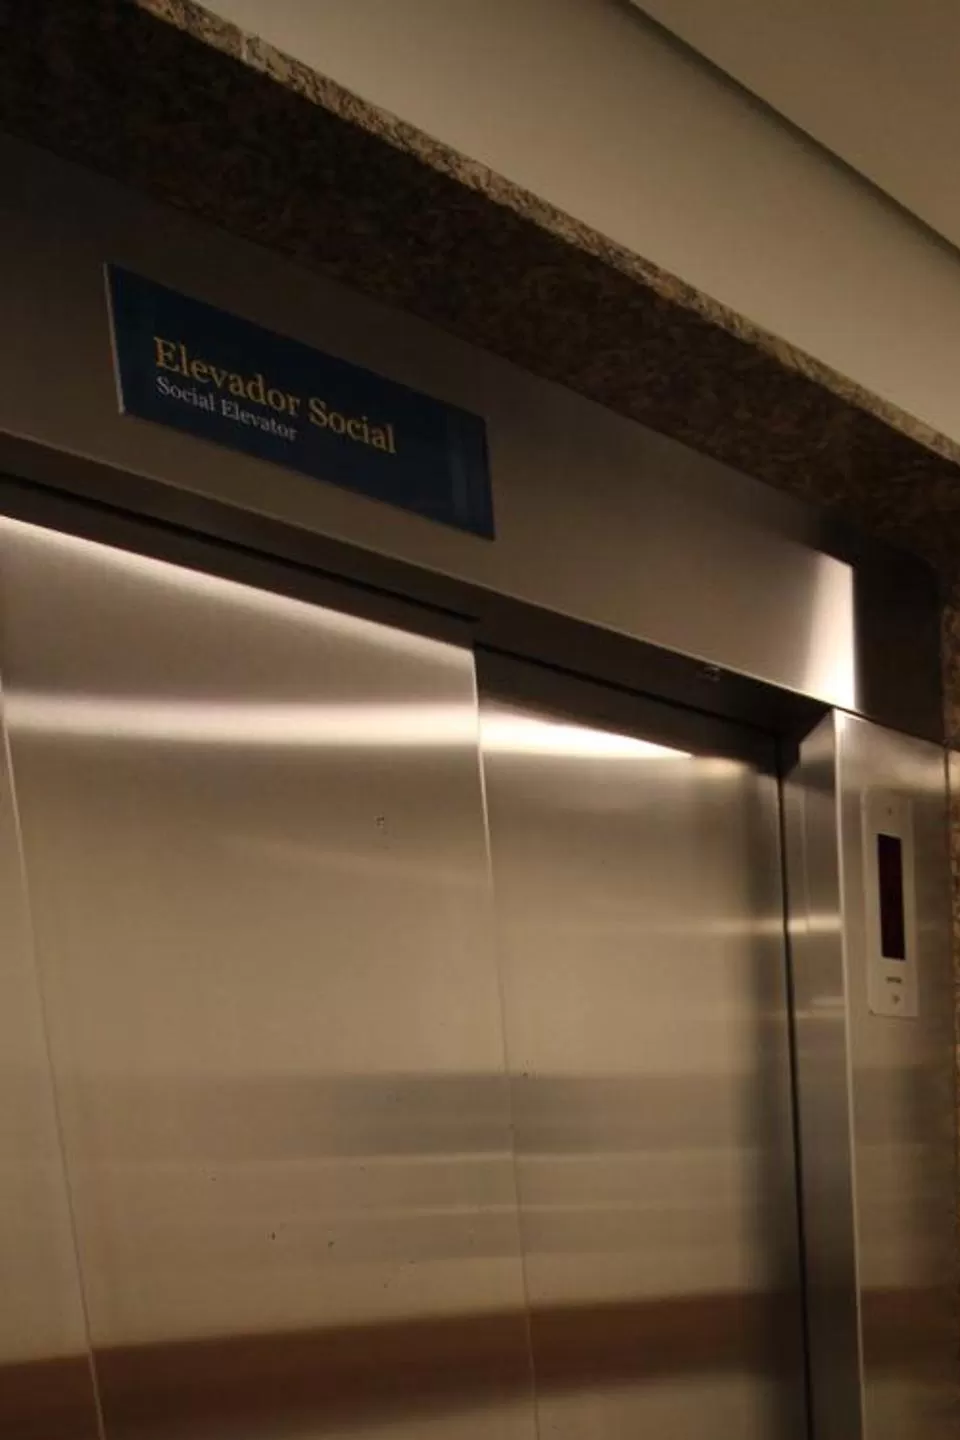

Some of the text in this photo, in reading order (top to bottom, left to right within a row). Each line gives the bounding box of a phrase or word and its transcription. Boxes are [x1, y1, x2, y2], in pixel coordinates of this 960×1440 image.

[153, 336, 397, 454] Elevador Social
[156, 375, 299, 442] Social Elevator
